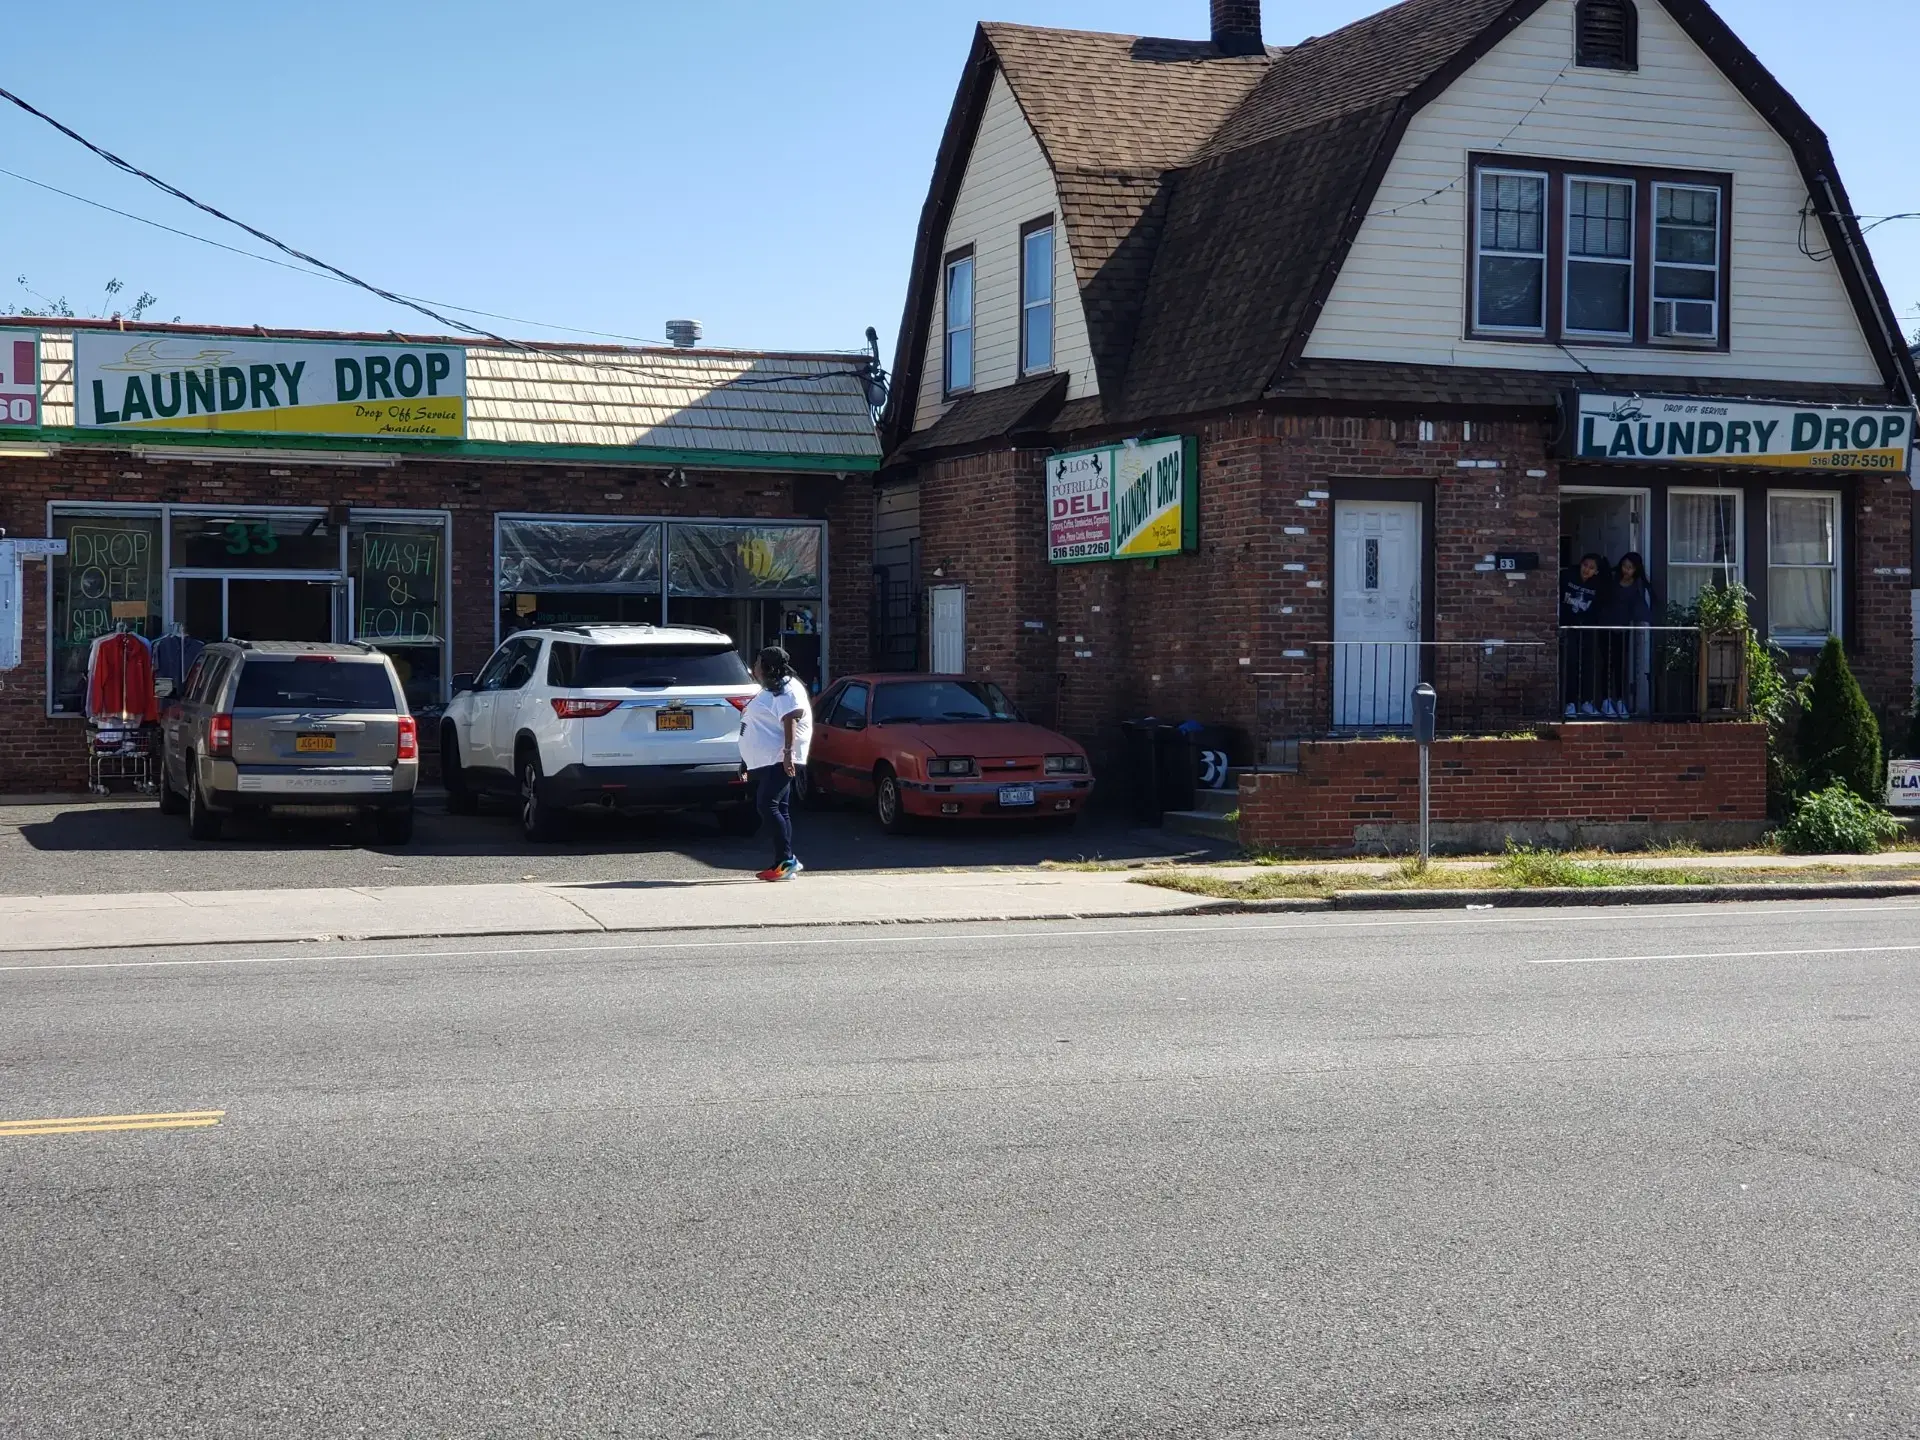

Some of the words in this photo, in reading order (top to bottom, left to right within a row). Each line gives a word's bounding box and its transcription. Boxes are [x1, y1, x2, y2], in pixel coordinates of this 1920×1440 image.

[92, 361, 306, 424] LAUNDRY
[335, 353, 450, 401] DROP
[353, 405, 383, 421] Drop
[388, 405, 411, 422] Off
[413, 407, 457, 421] Service
[1663, 404, 1684, 412] DROP
[1685, 405, 1698, 413] OFF
[1700, 406, 1729, 415] SERVICE
[377, 424, 437, 434] Available
[1581, 417, 1779, 456] LAUNDRY
[1790, 412, 1905, 451] DROP
[1070, 459, 1089, 473] LOS
[1832, 453, 1895, 468] 887-5501
[1052, 476, 1109, 498] POTRILLOS
[1116, 466, 1153, 549] LAUNDRY
[1157, 450, 1179, 509] DROP
[1053, 491, 1109, 518] DELI
[74, 533, 148, 567] DROP
[225, 522, 280, 555] 33
[1053, 547, 1067, 559] 516
[1069, 542, 1110, 557] 599.2260
[365, 539, 432, 576] WASH
[1501, 559, 1515, 568] 33
[81, 566, 139, 599] OFF
[387, 575, 416, 606] &
[363, 608, 431, 642] FOLD
